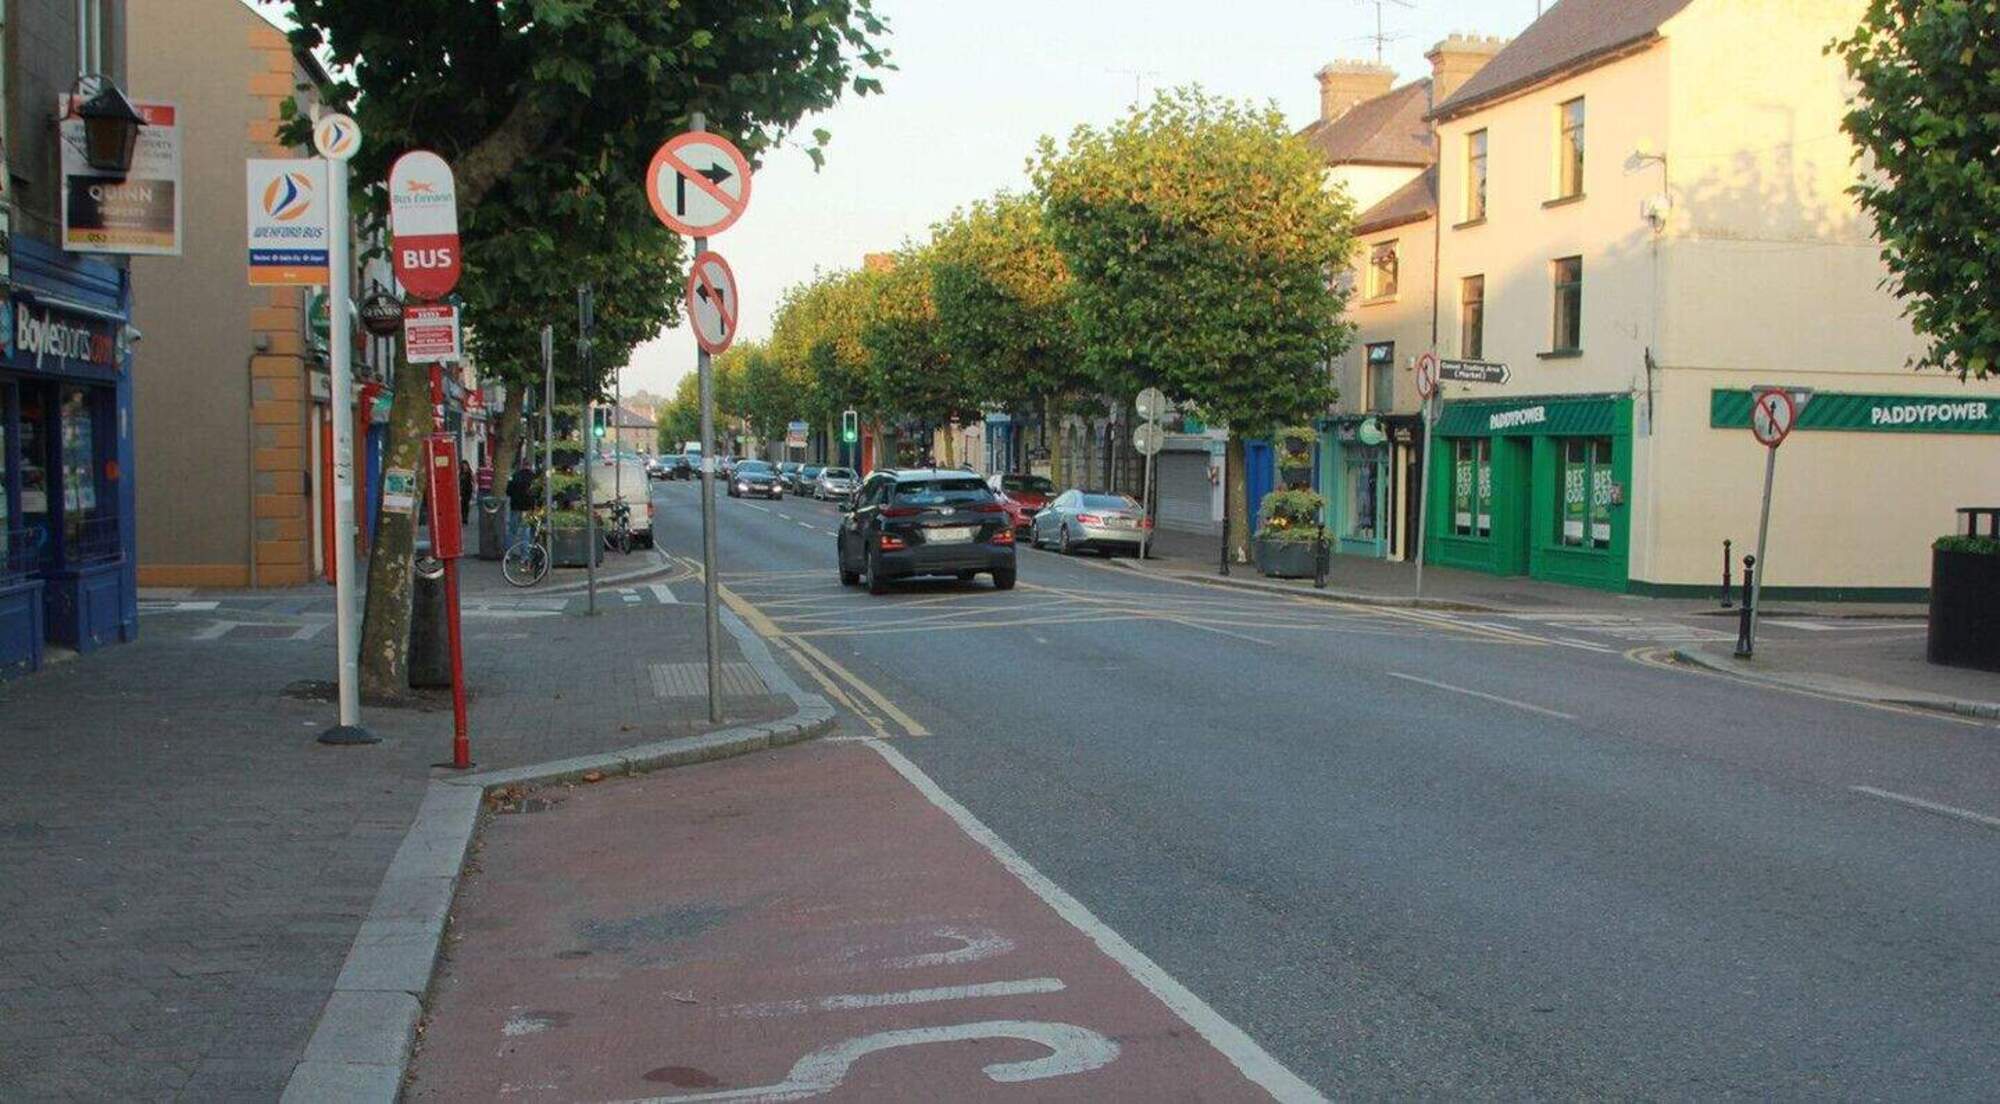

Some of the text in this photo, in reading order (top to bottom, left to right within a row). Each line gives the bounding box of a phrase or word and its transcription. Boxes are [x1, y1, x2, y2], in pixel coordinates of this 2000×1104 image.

[89, 184, 152, 203] QUINN
[303, 225, 325, 239] BUS
[403, 248, 452, 269] BUS
